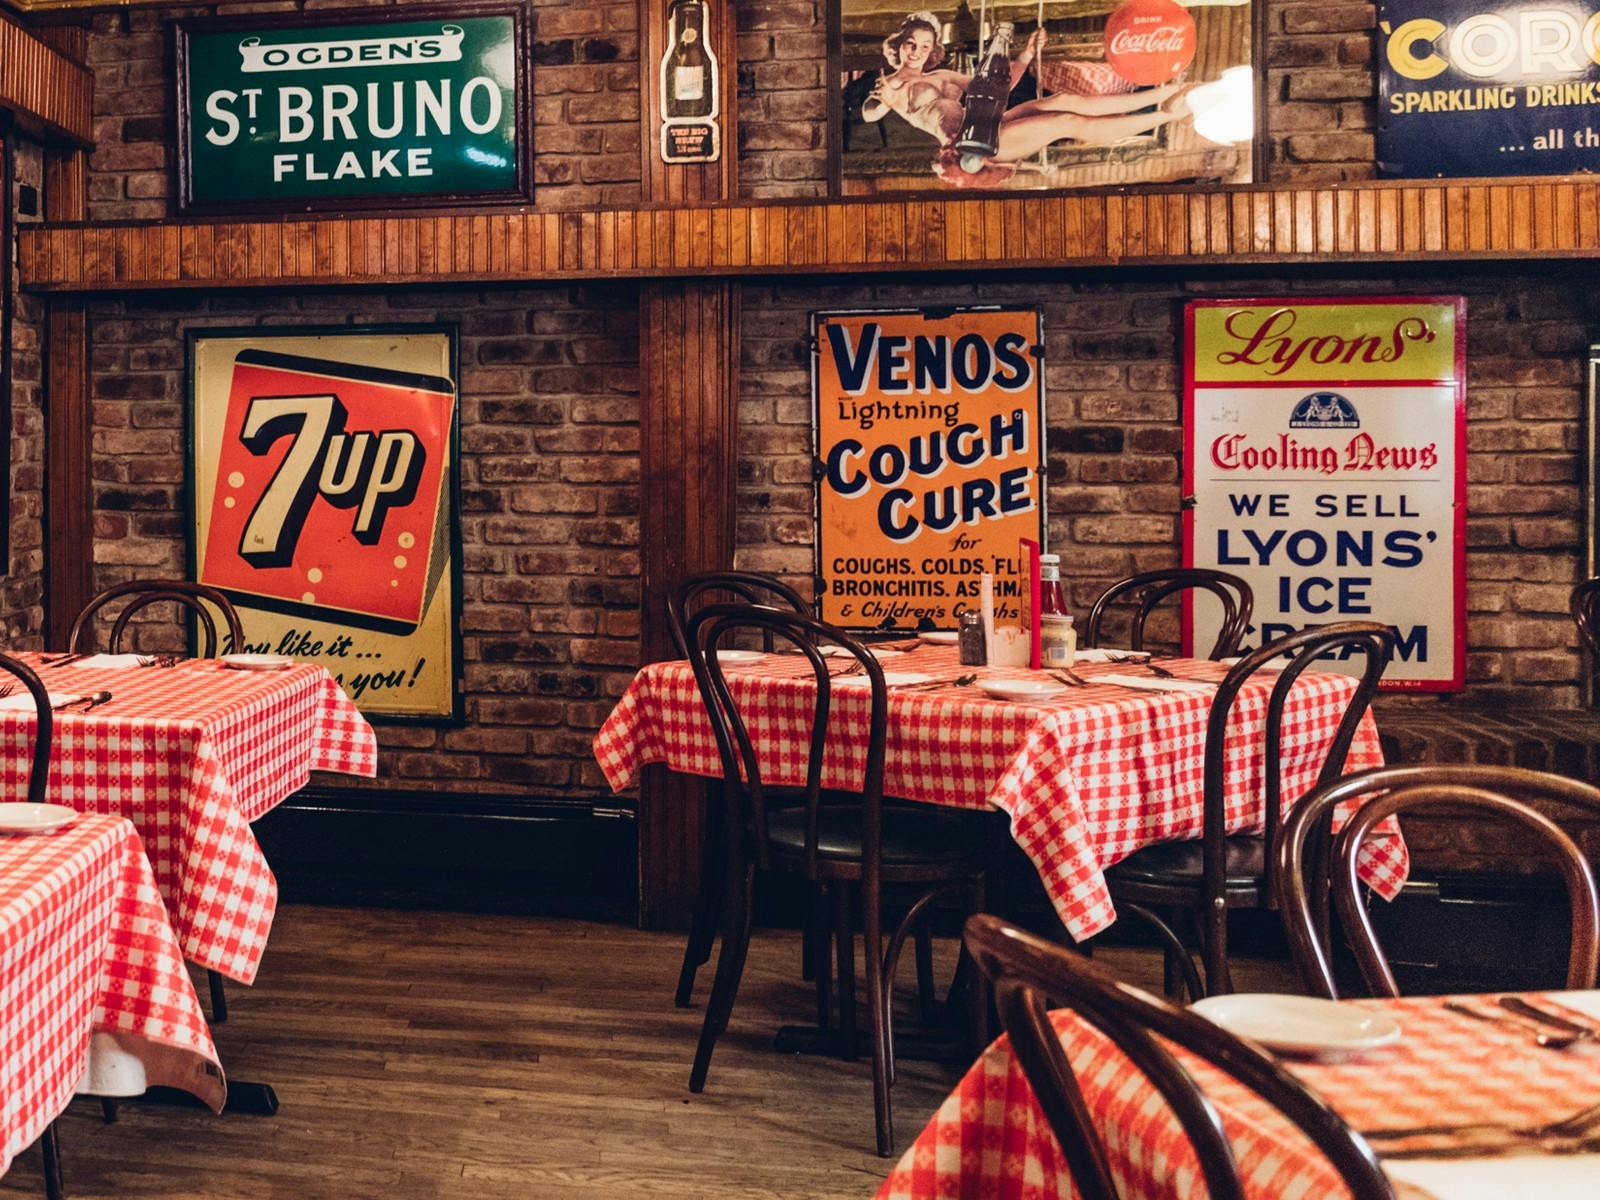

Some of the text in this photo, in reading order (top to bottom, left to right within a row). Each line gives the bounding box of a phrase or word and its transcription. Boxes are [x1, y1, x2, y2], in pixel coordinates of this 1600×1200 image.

[1133, 15, 1163, 25] DRINK
[262, 38, 443, 67] OGDEN'S
[278, 76, 503, 143] BRUNO
[1390, 87, 1517, 114] SPARKLING
[1533, 128, 1564, 150] all
[273, 148, 434, 183] FLAKE
[826, 323, 1040, 398] VENOS
[839, 401, 961, 430] Lightning
[827, 408, 1029, 499] COUGH
[1211, 432, 1438, 475] Cooling News
[877, 467, 1039, 543] CURE
[1229, 494, 1420, 517] WE SELL
[952, 533, 982, 553] for
[1217, 530, 1438, 568] LYONS'
[955, 580, 1022, 598] ASHM
[1279, 577, 1372, 615] ICE
[841, 605, 853, 617] &
[861, 601, 945, 620] Children's
[275, 628, 323, 657] like
[325, 634, 353, 657] it
